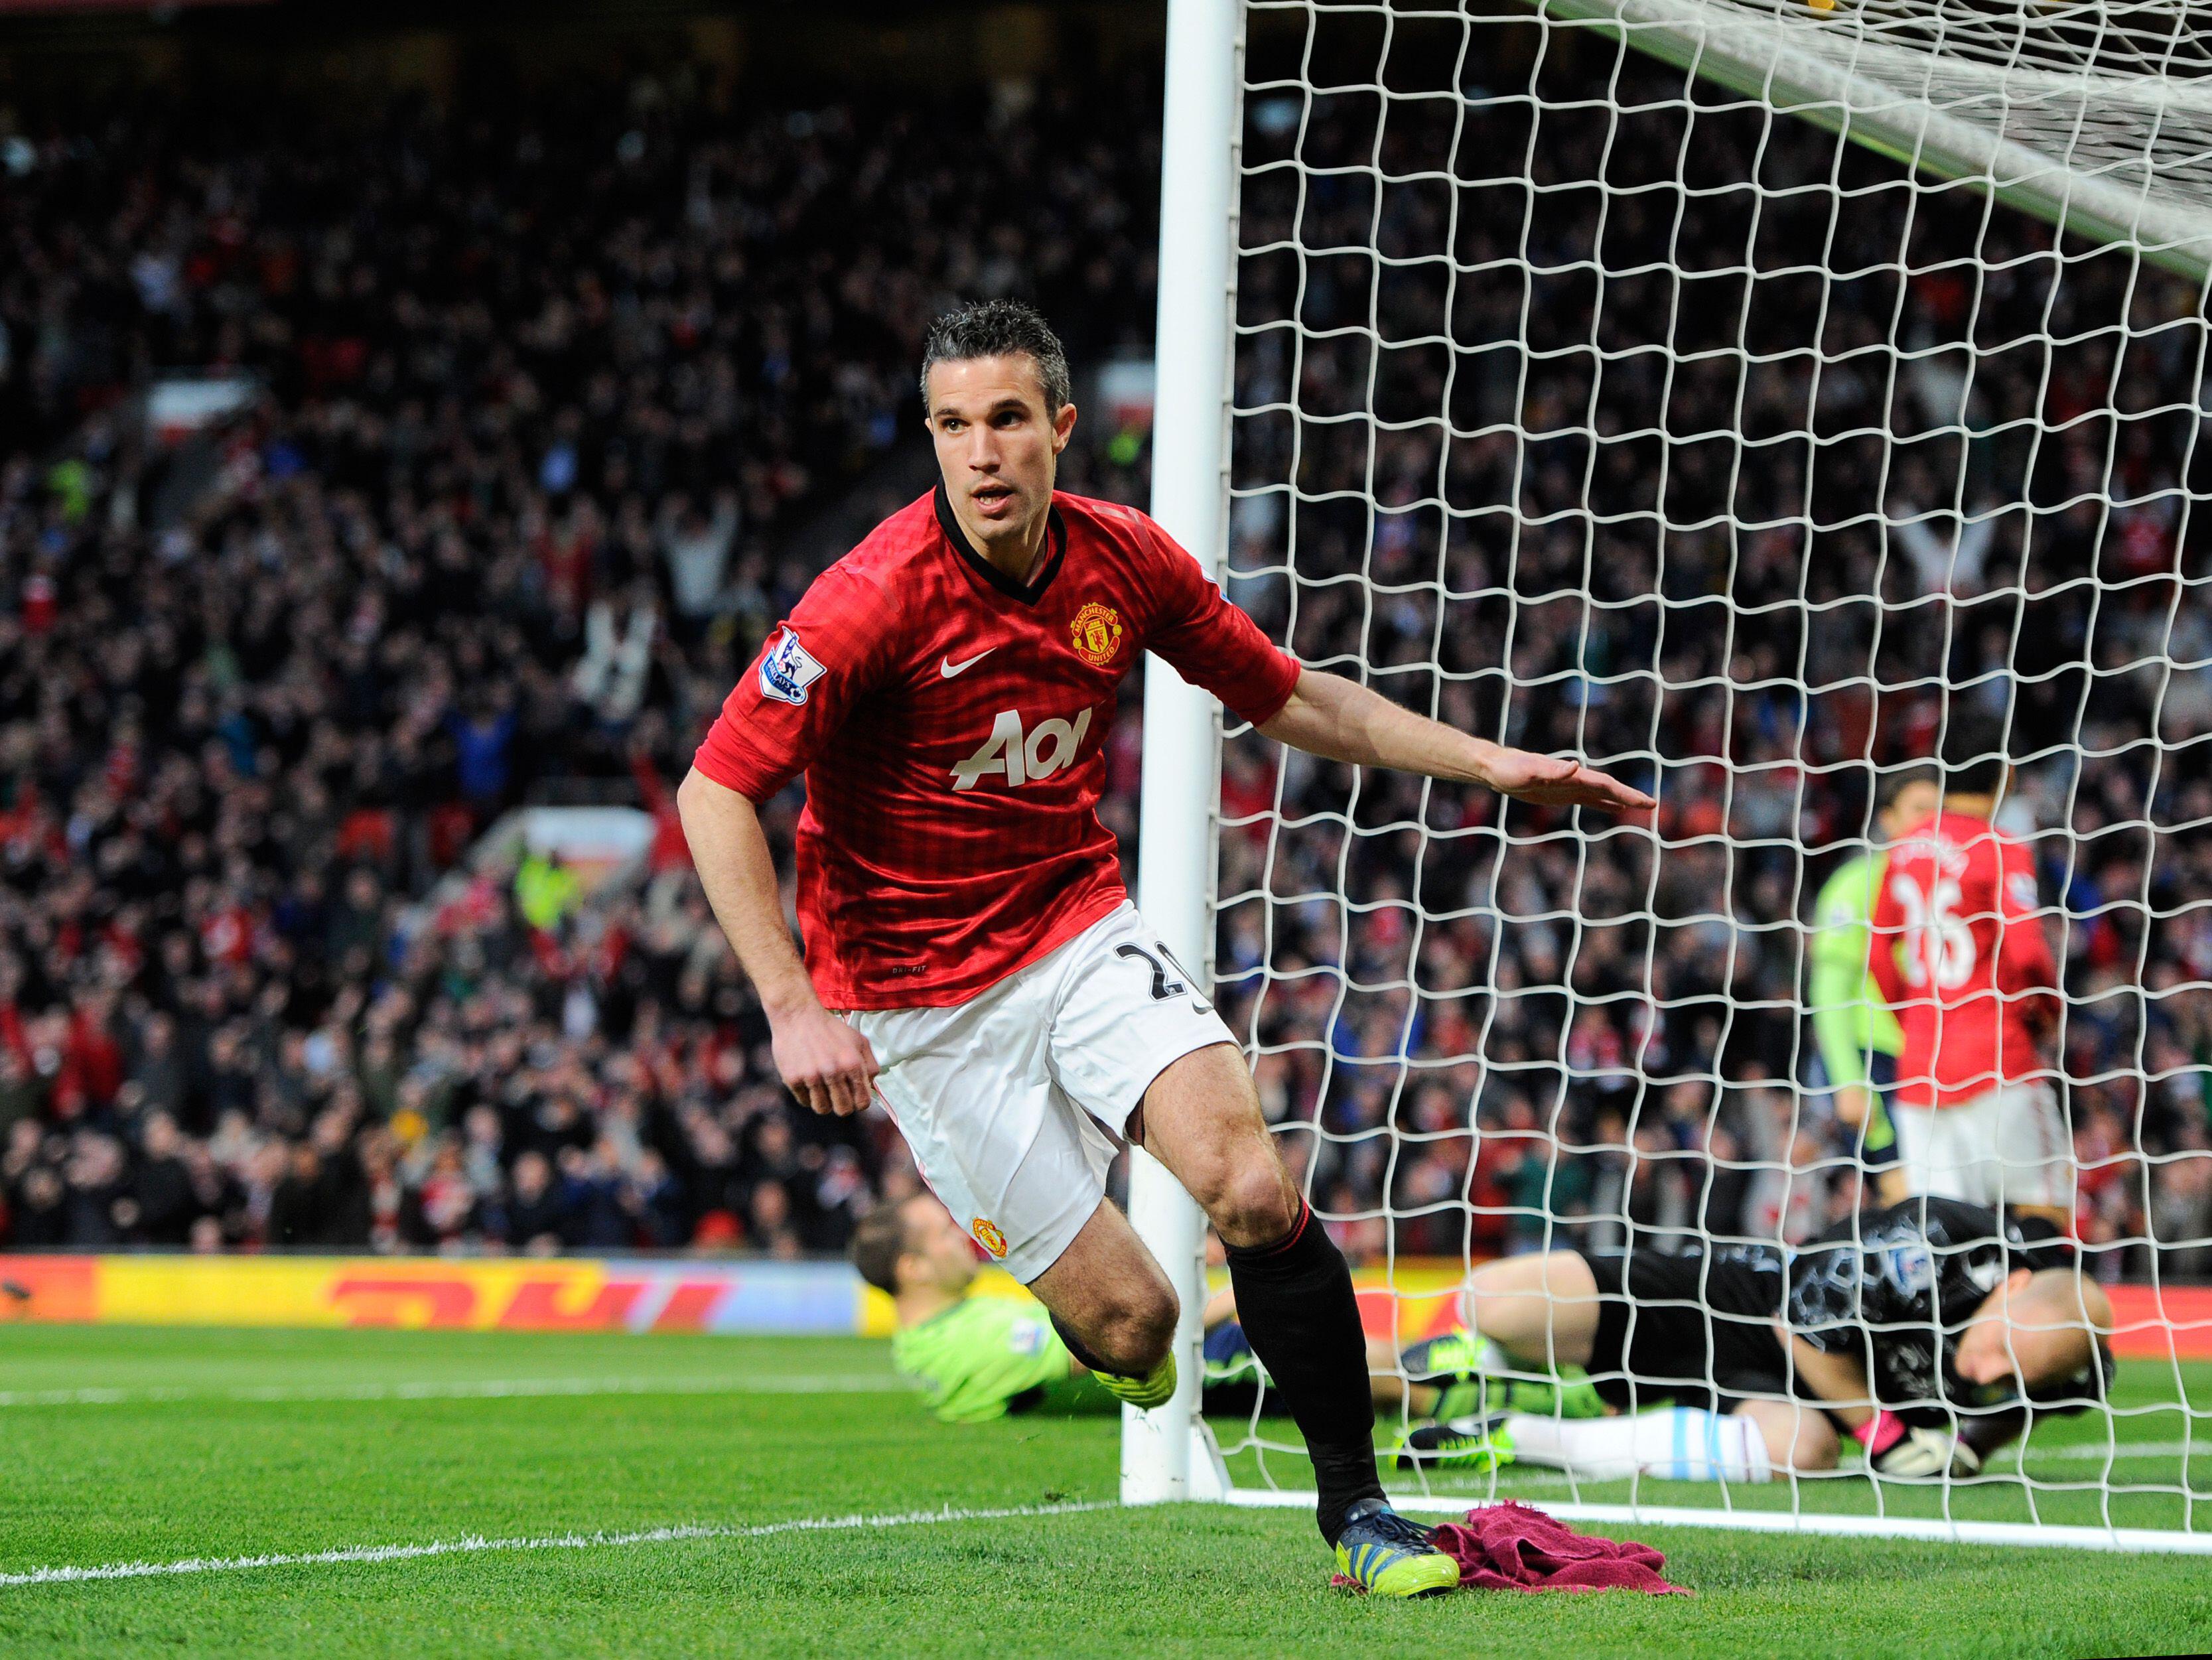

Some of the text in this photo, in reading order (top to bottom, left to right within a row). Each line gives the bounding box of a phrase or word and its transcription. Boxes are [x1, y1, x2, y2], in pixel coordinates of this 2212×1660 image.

[1075, 606, 1114, 633] MANCHESTER
[1088, 646, 1115, 662] UNITED
[1890, 873, 1976, 989] 16
[892, 965, 926, 974] DRI-FIT
